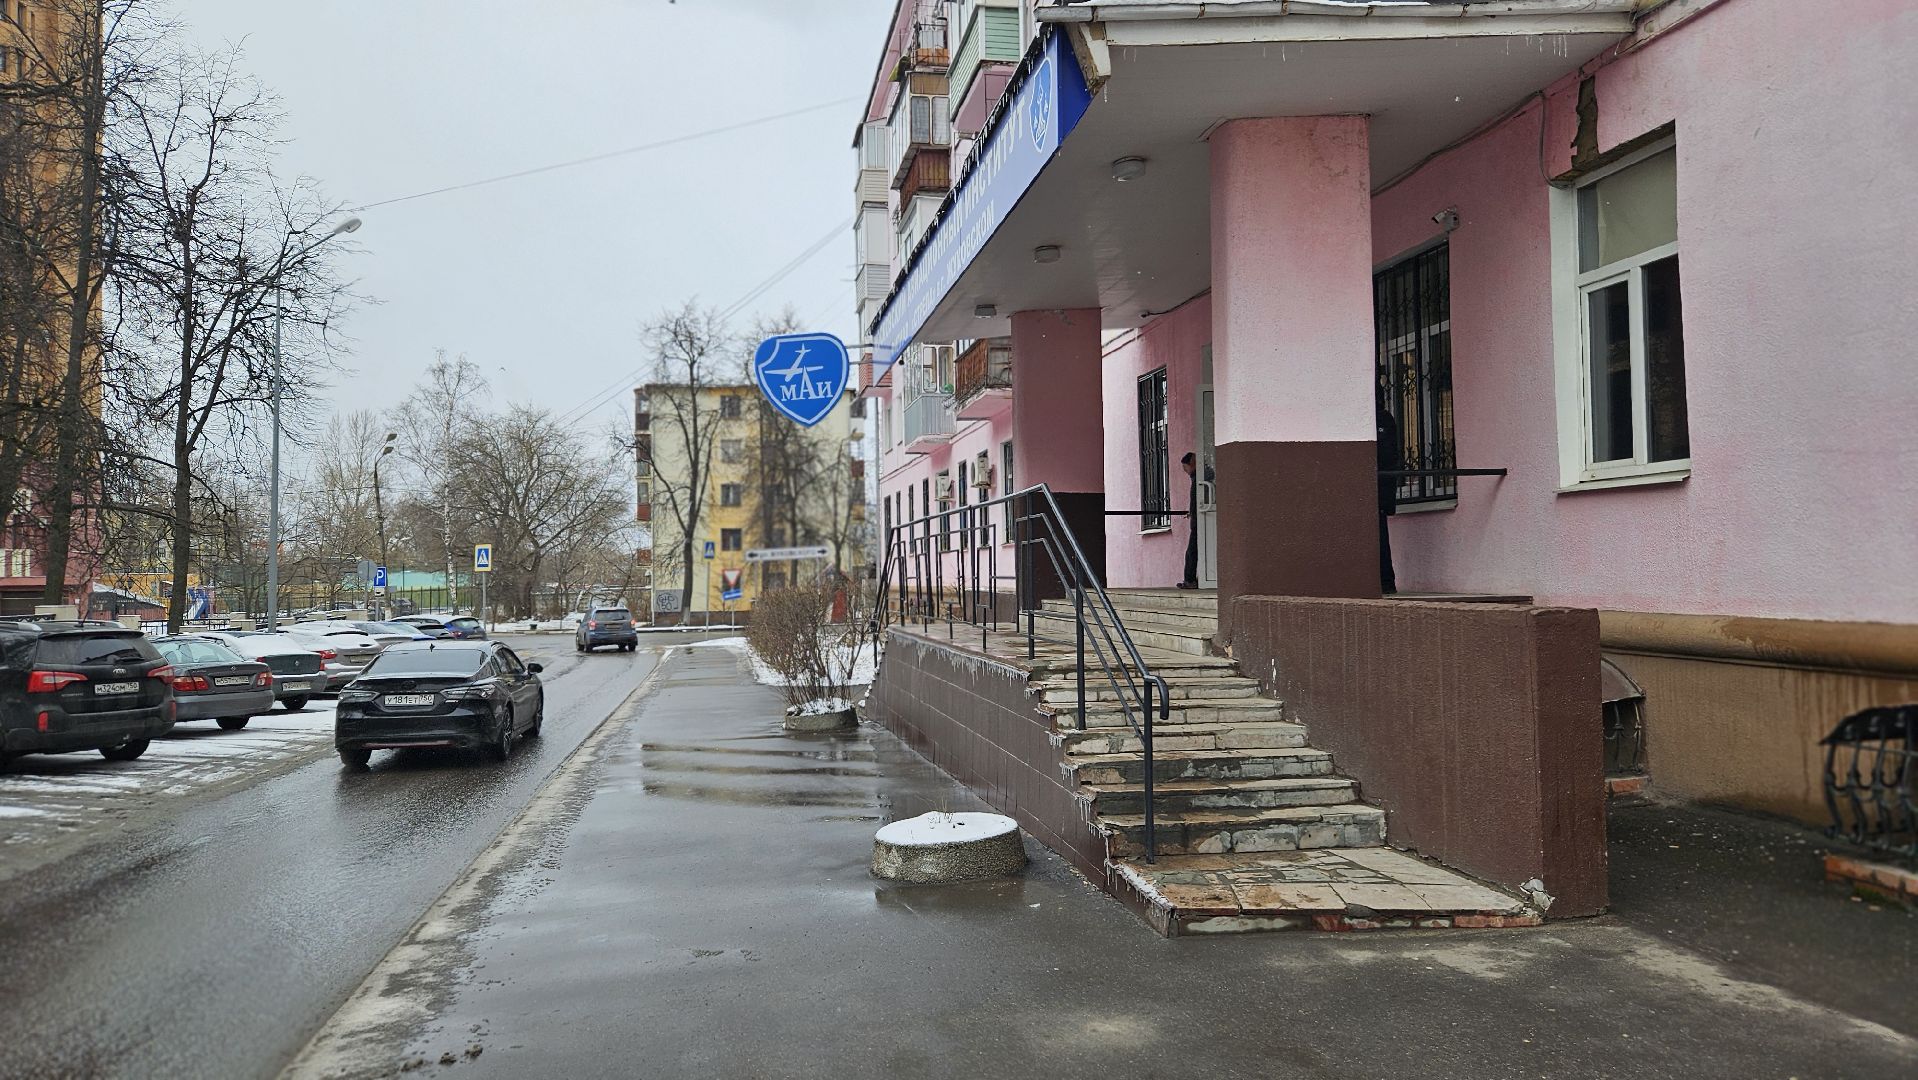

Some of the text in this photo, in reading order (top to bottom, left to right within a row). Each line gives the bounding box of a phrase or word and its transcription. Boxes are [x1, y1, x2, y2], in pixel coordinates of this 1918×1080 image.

[907, 197, 962, 307] АВИАЦИОННЫЙ
[964, 94, 1025, 220] ИНСТИТУТ
[946, 199, 994, 285] ЖУКОВСКОМ
[779, 365, 833, 402] МАИ
